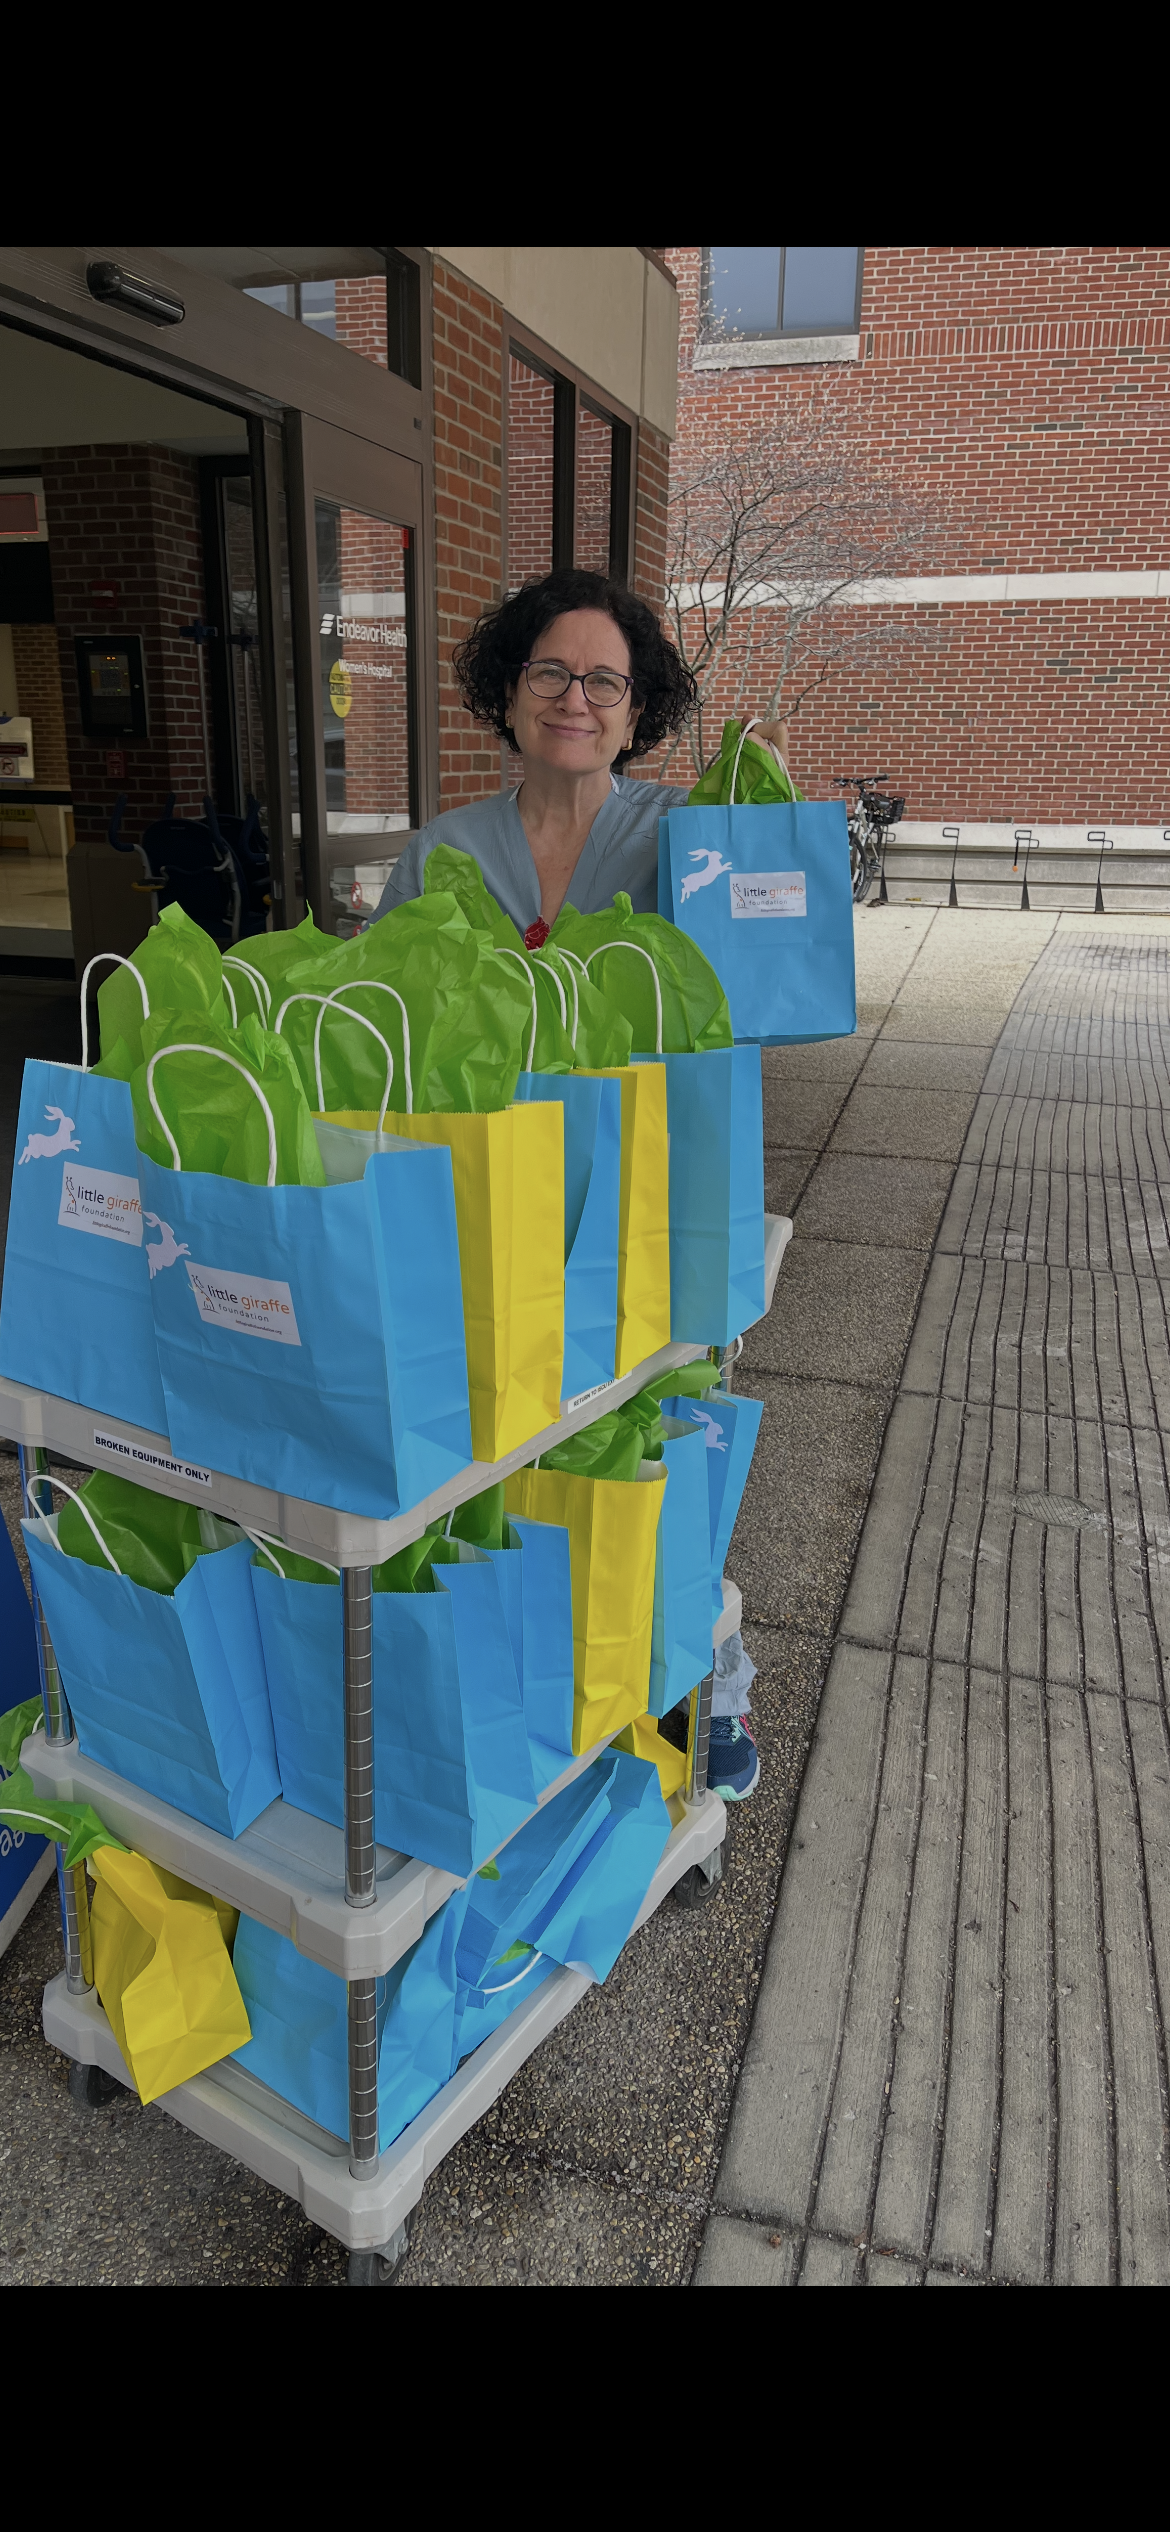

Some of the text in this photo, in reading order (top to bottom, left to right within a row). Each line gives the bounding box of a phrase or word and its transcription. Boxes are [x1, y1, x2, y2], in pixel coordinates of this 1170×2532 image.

[336, 615, 407, 648] Endeavor Health
[338, 659, 367, 675] Women's
[368, 662, 392, 679] Hospital
[743, 885, 804, 898] little giraffe
[77, 1185, 105, 1204] little
[81, 1204, 125, 1222] foundation
[207, 1285, 290, 1314] little giraffe
[218, 1303, 269, 1322] foundation
[95, 1436, 210, 1482] BROKEN EQUIPMENT ONLY
